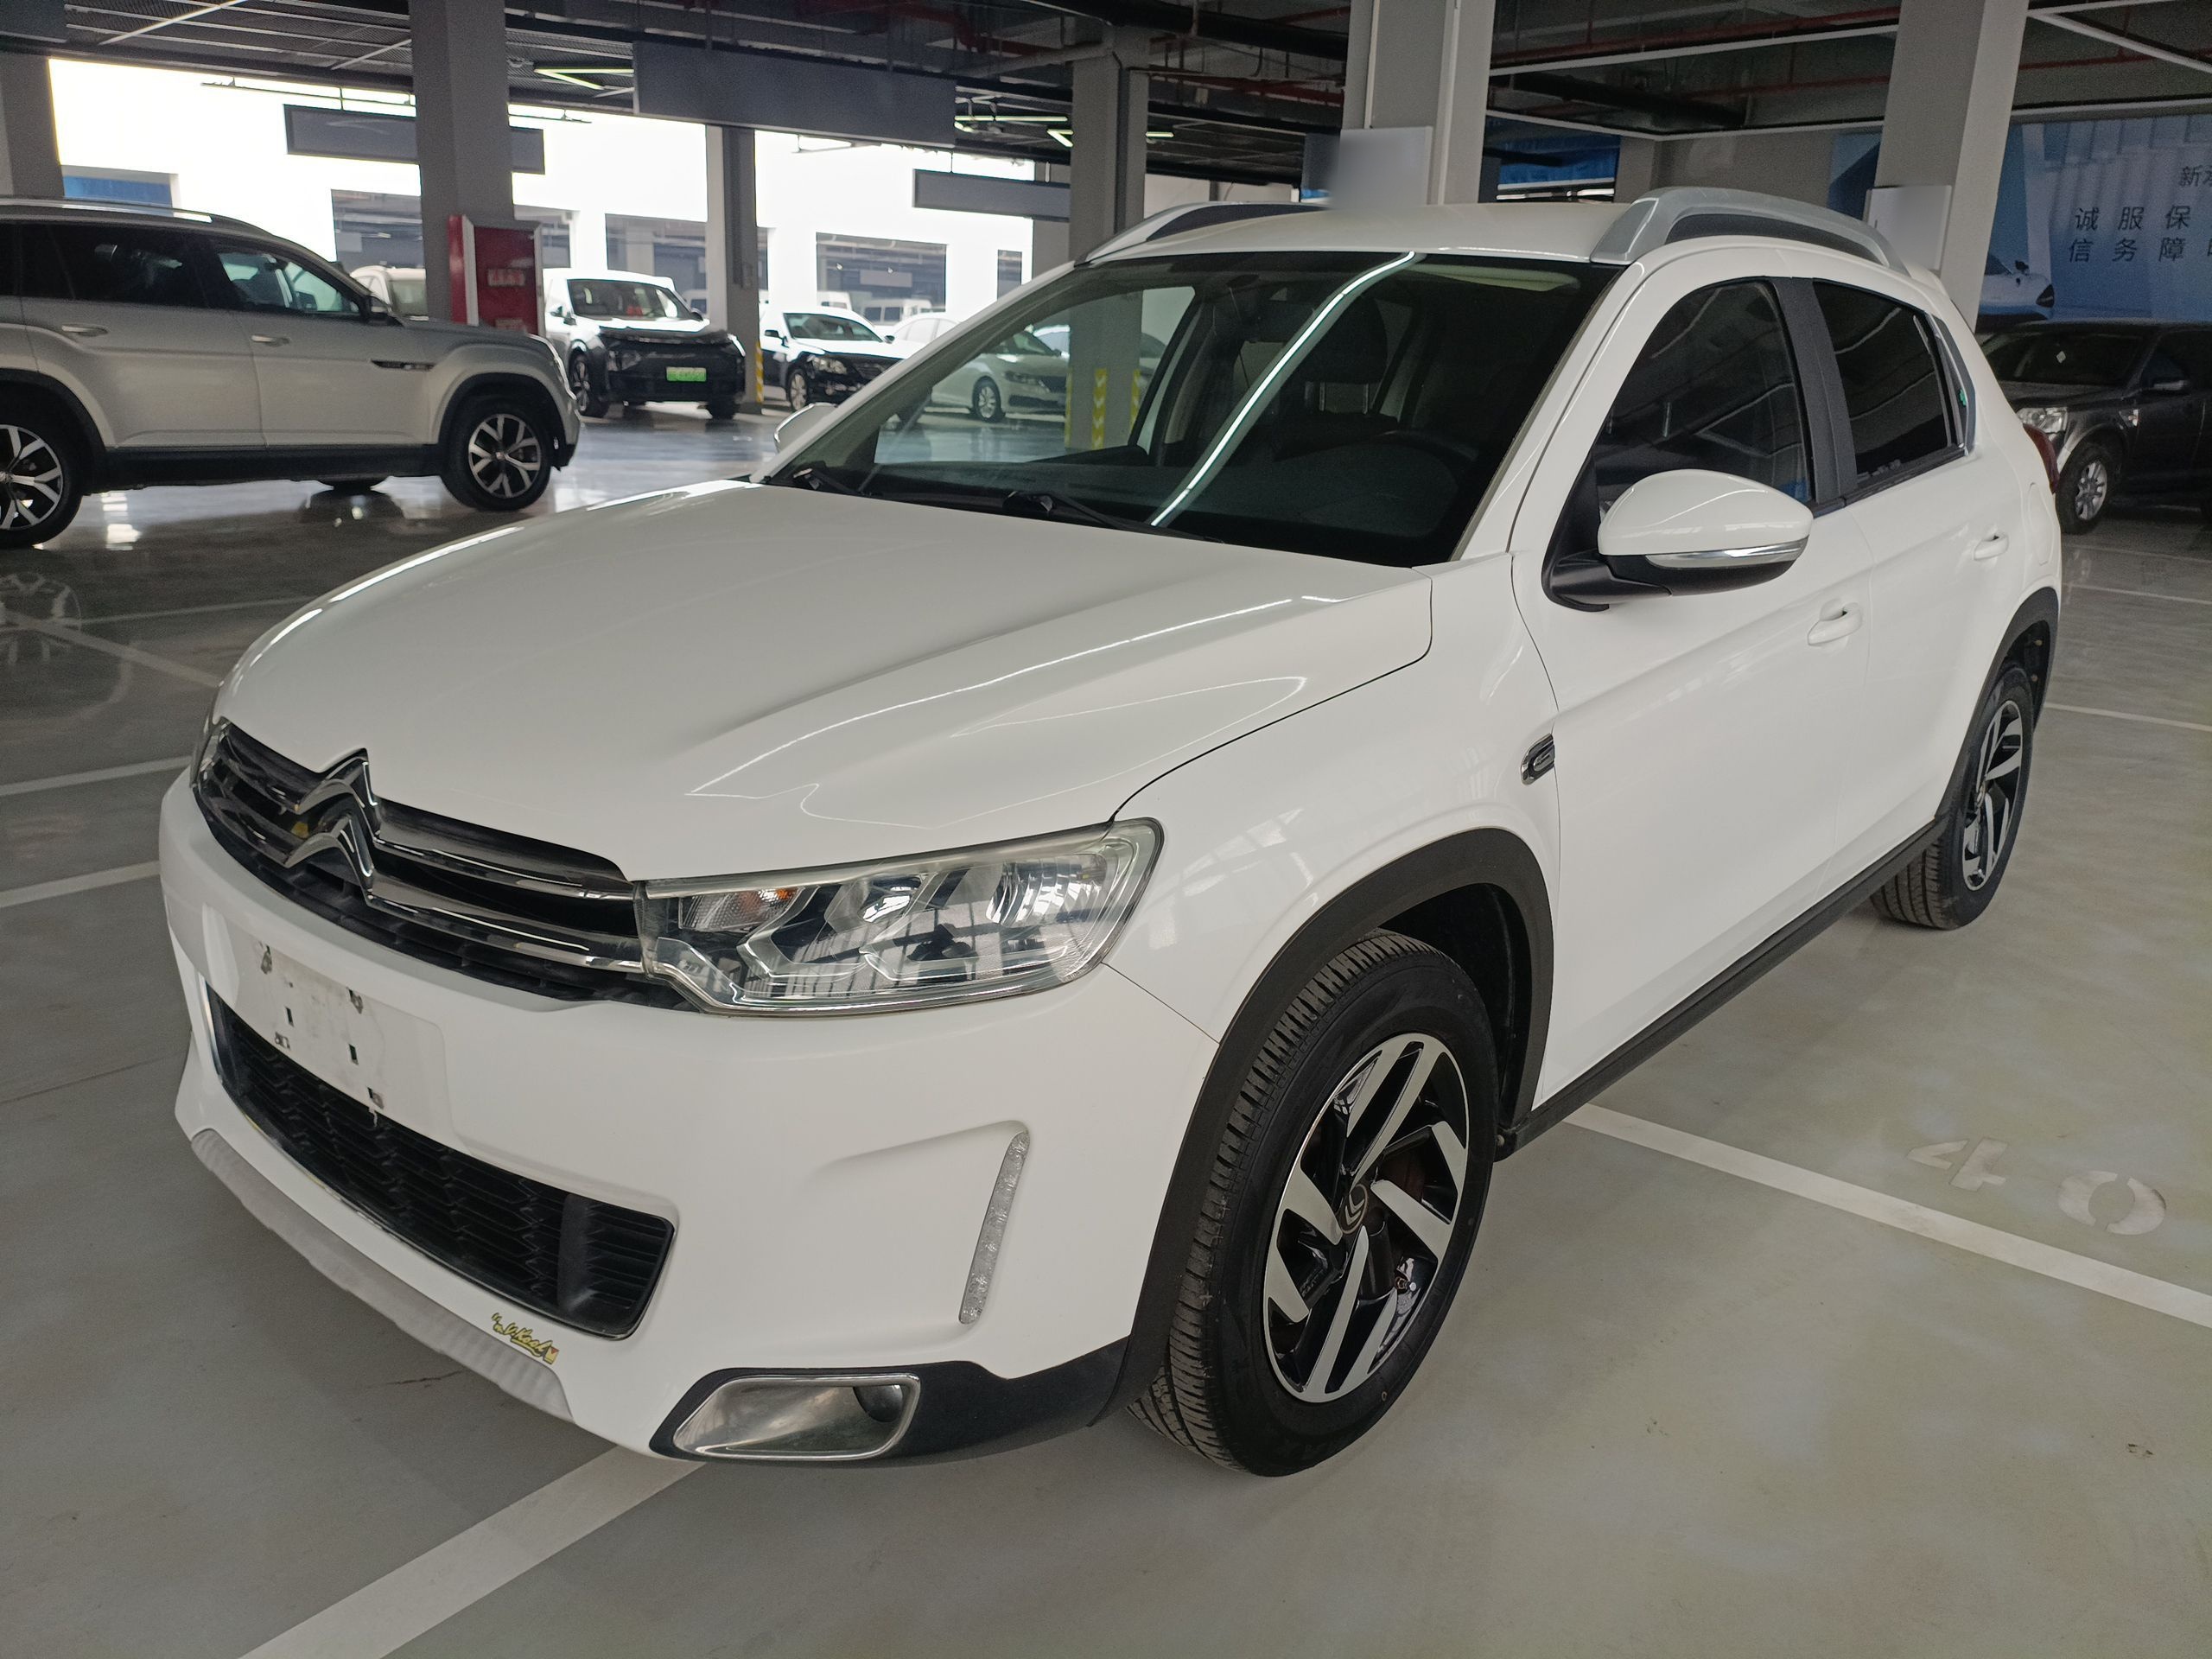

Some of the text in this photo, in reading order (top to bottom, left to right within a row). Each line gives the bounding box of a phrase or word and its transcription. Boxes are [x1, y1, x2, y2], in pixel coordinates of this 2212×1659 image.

[2069, 207, 2100, 263] 诚信
[2112, 207, 2145, 262] 服务
[2158, 205, 2191, 262] 保障
[1906, 1136, 2166, 1236] 40
